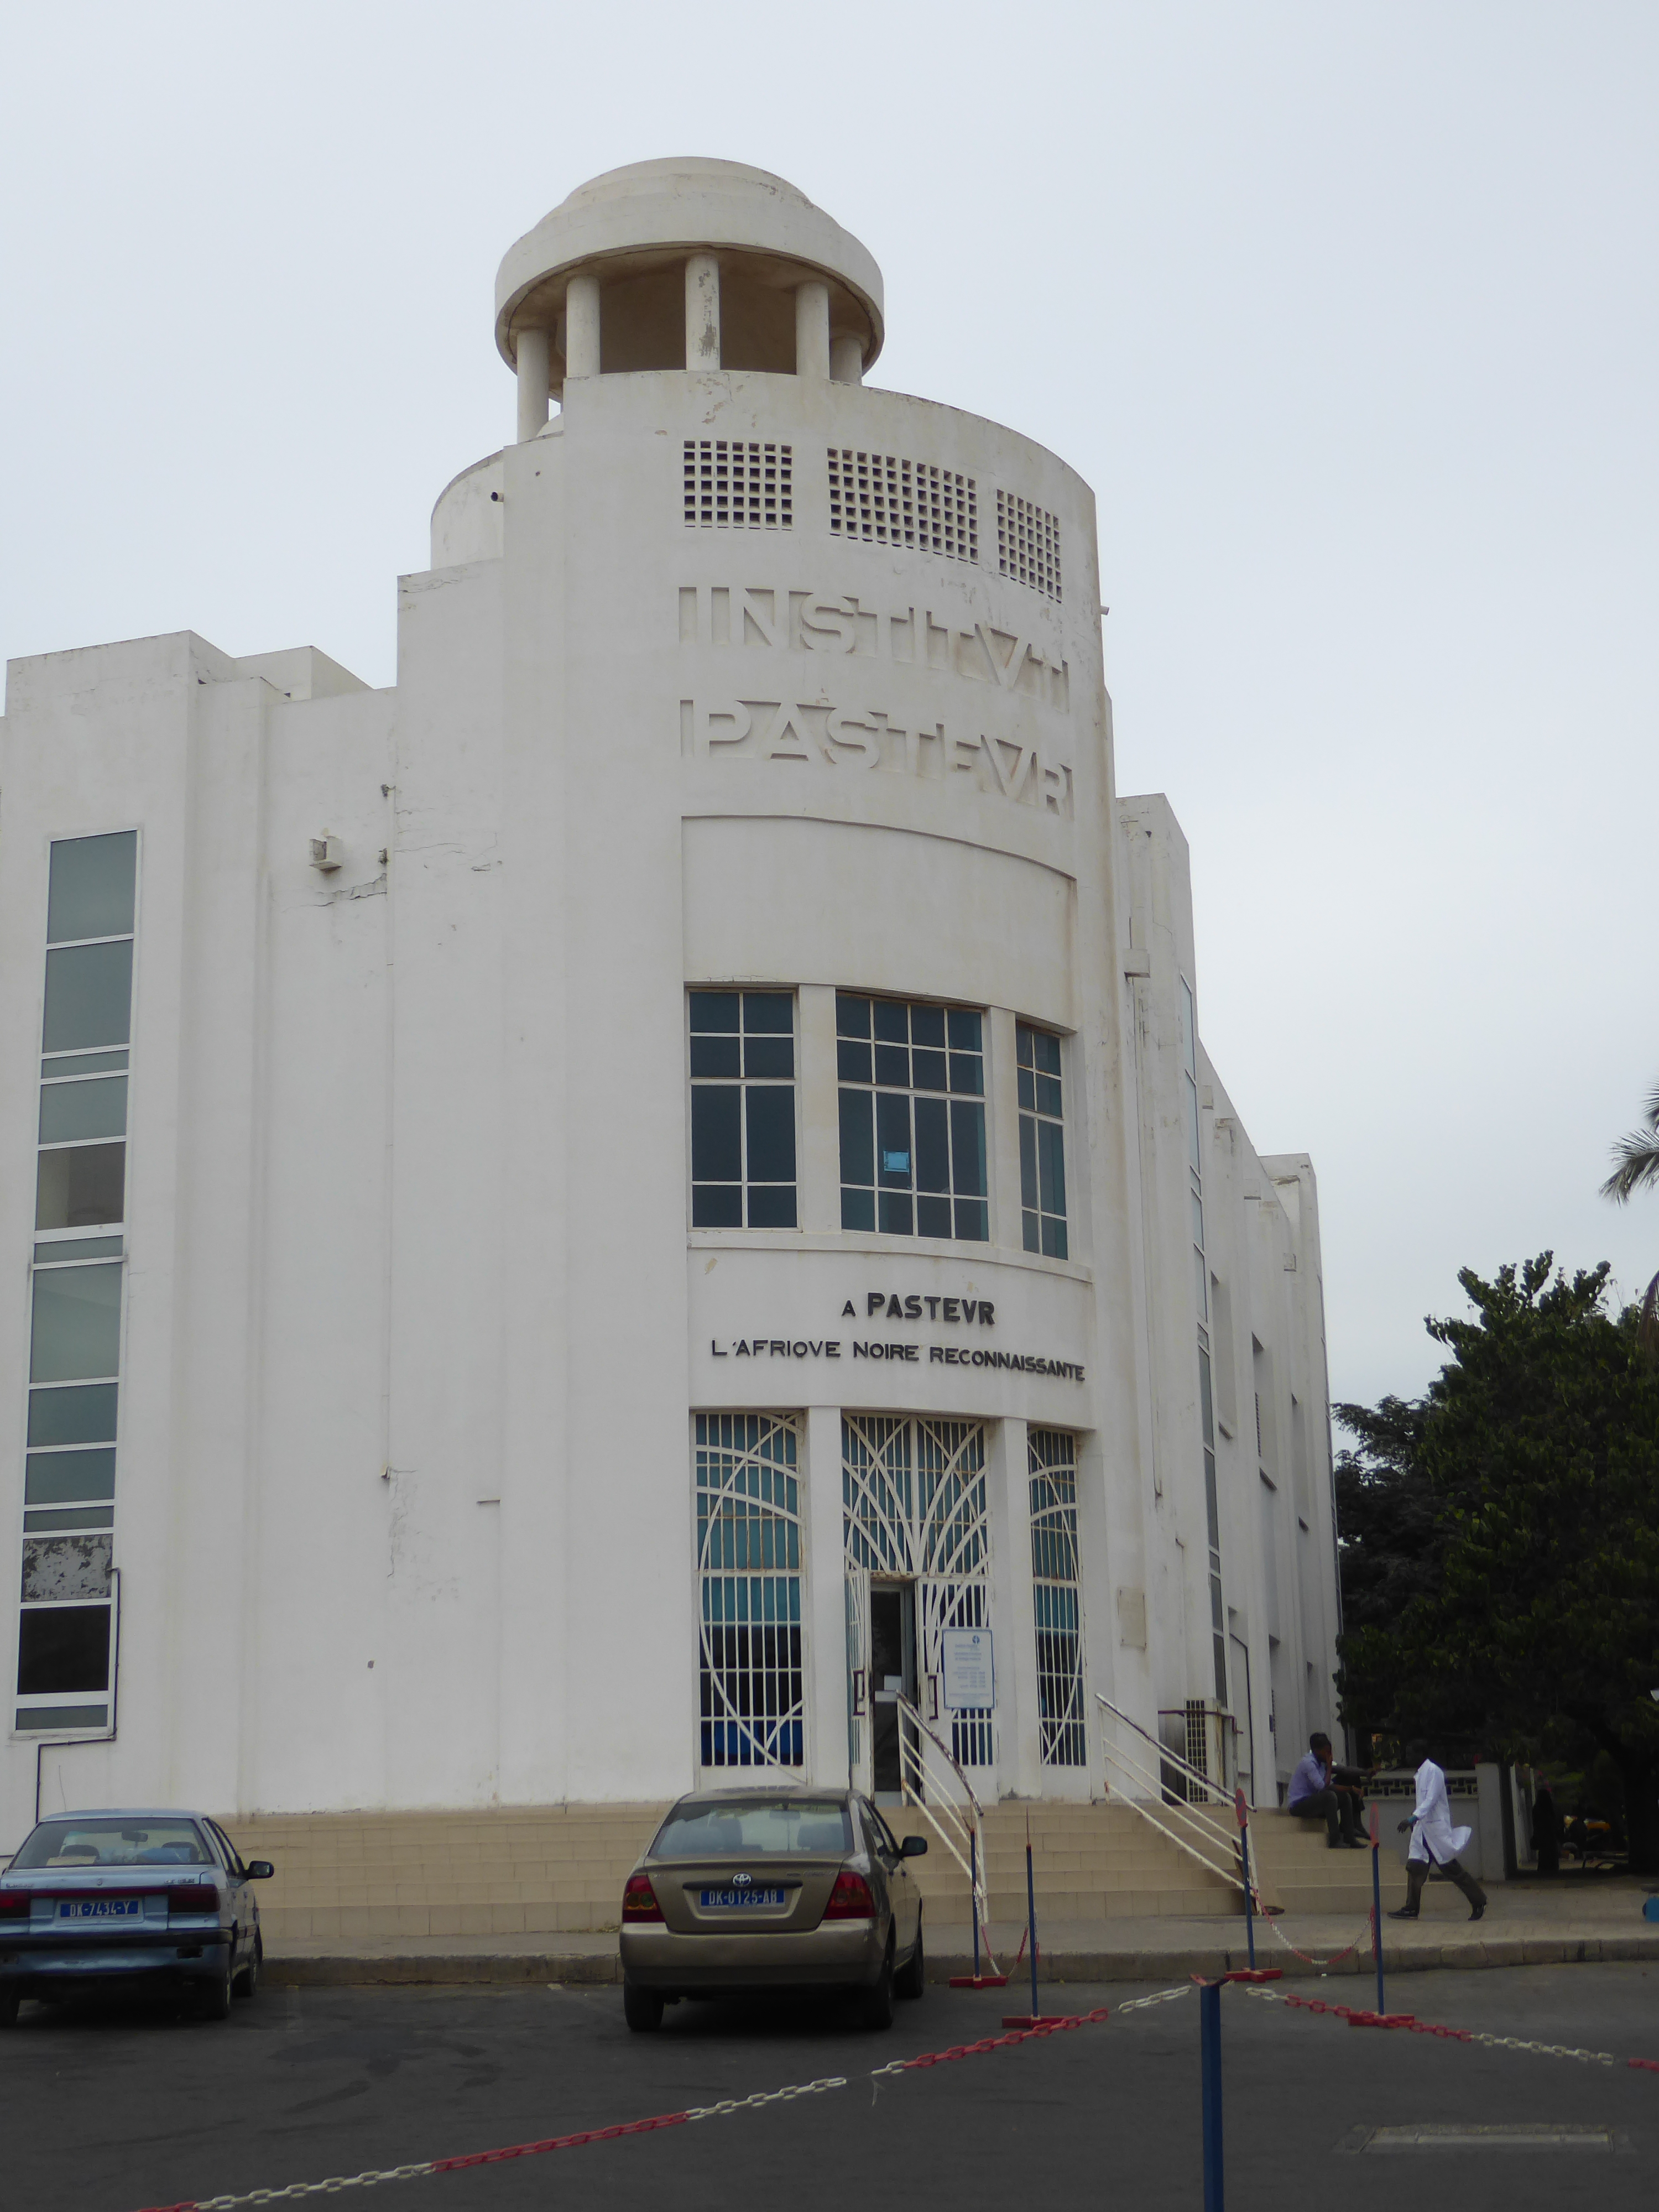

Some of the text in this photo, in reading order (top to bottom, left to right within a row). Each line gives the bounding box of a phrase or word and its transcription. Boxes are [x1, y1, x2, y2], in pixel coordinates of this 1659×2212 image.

[692, 699, 1068, 820] PASTEVR
[842, 1292, 995, 1325] A PASTEVR
[853, 1342, 919, 1361] NOIRE
[930, 1347, 1086, 1381] RECONNAISSANTE
[70, 1901, 129, 1917] DK-7434-Y
